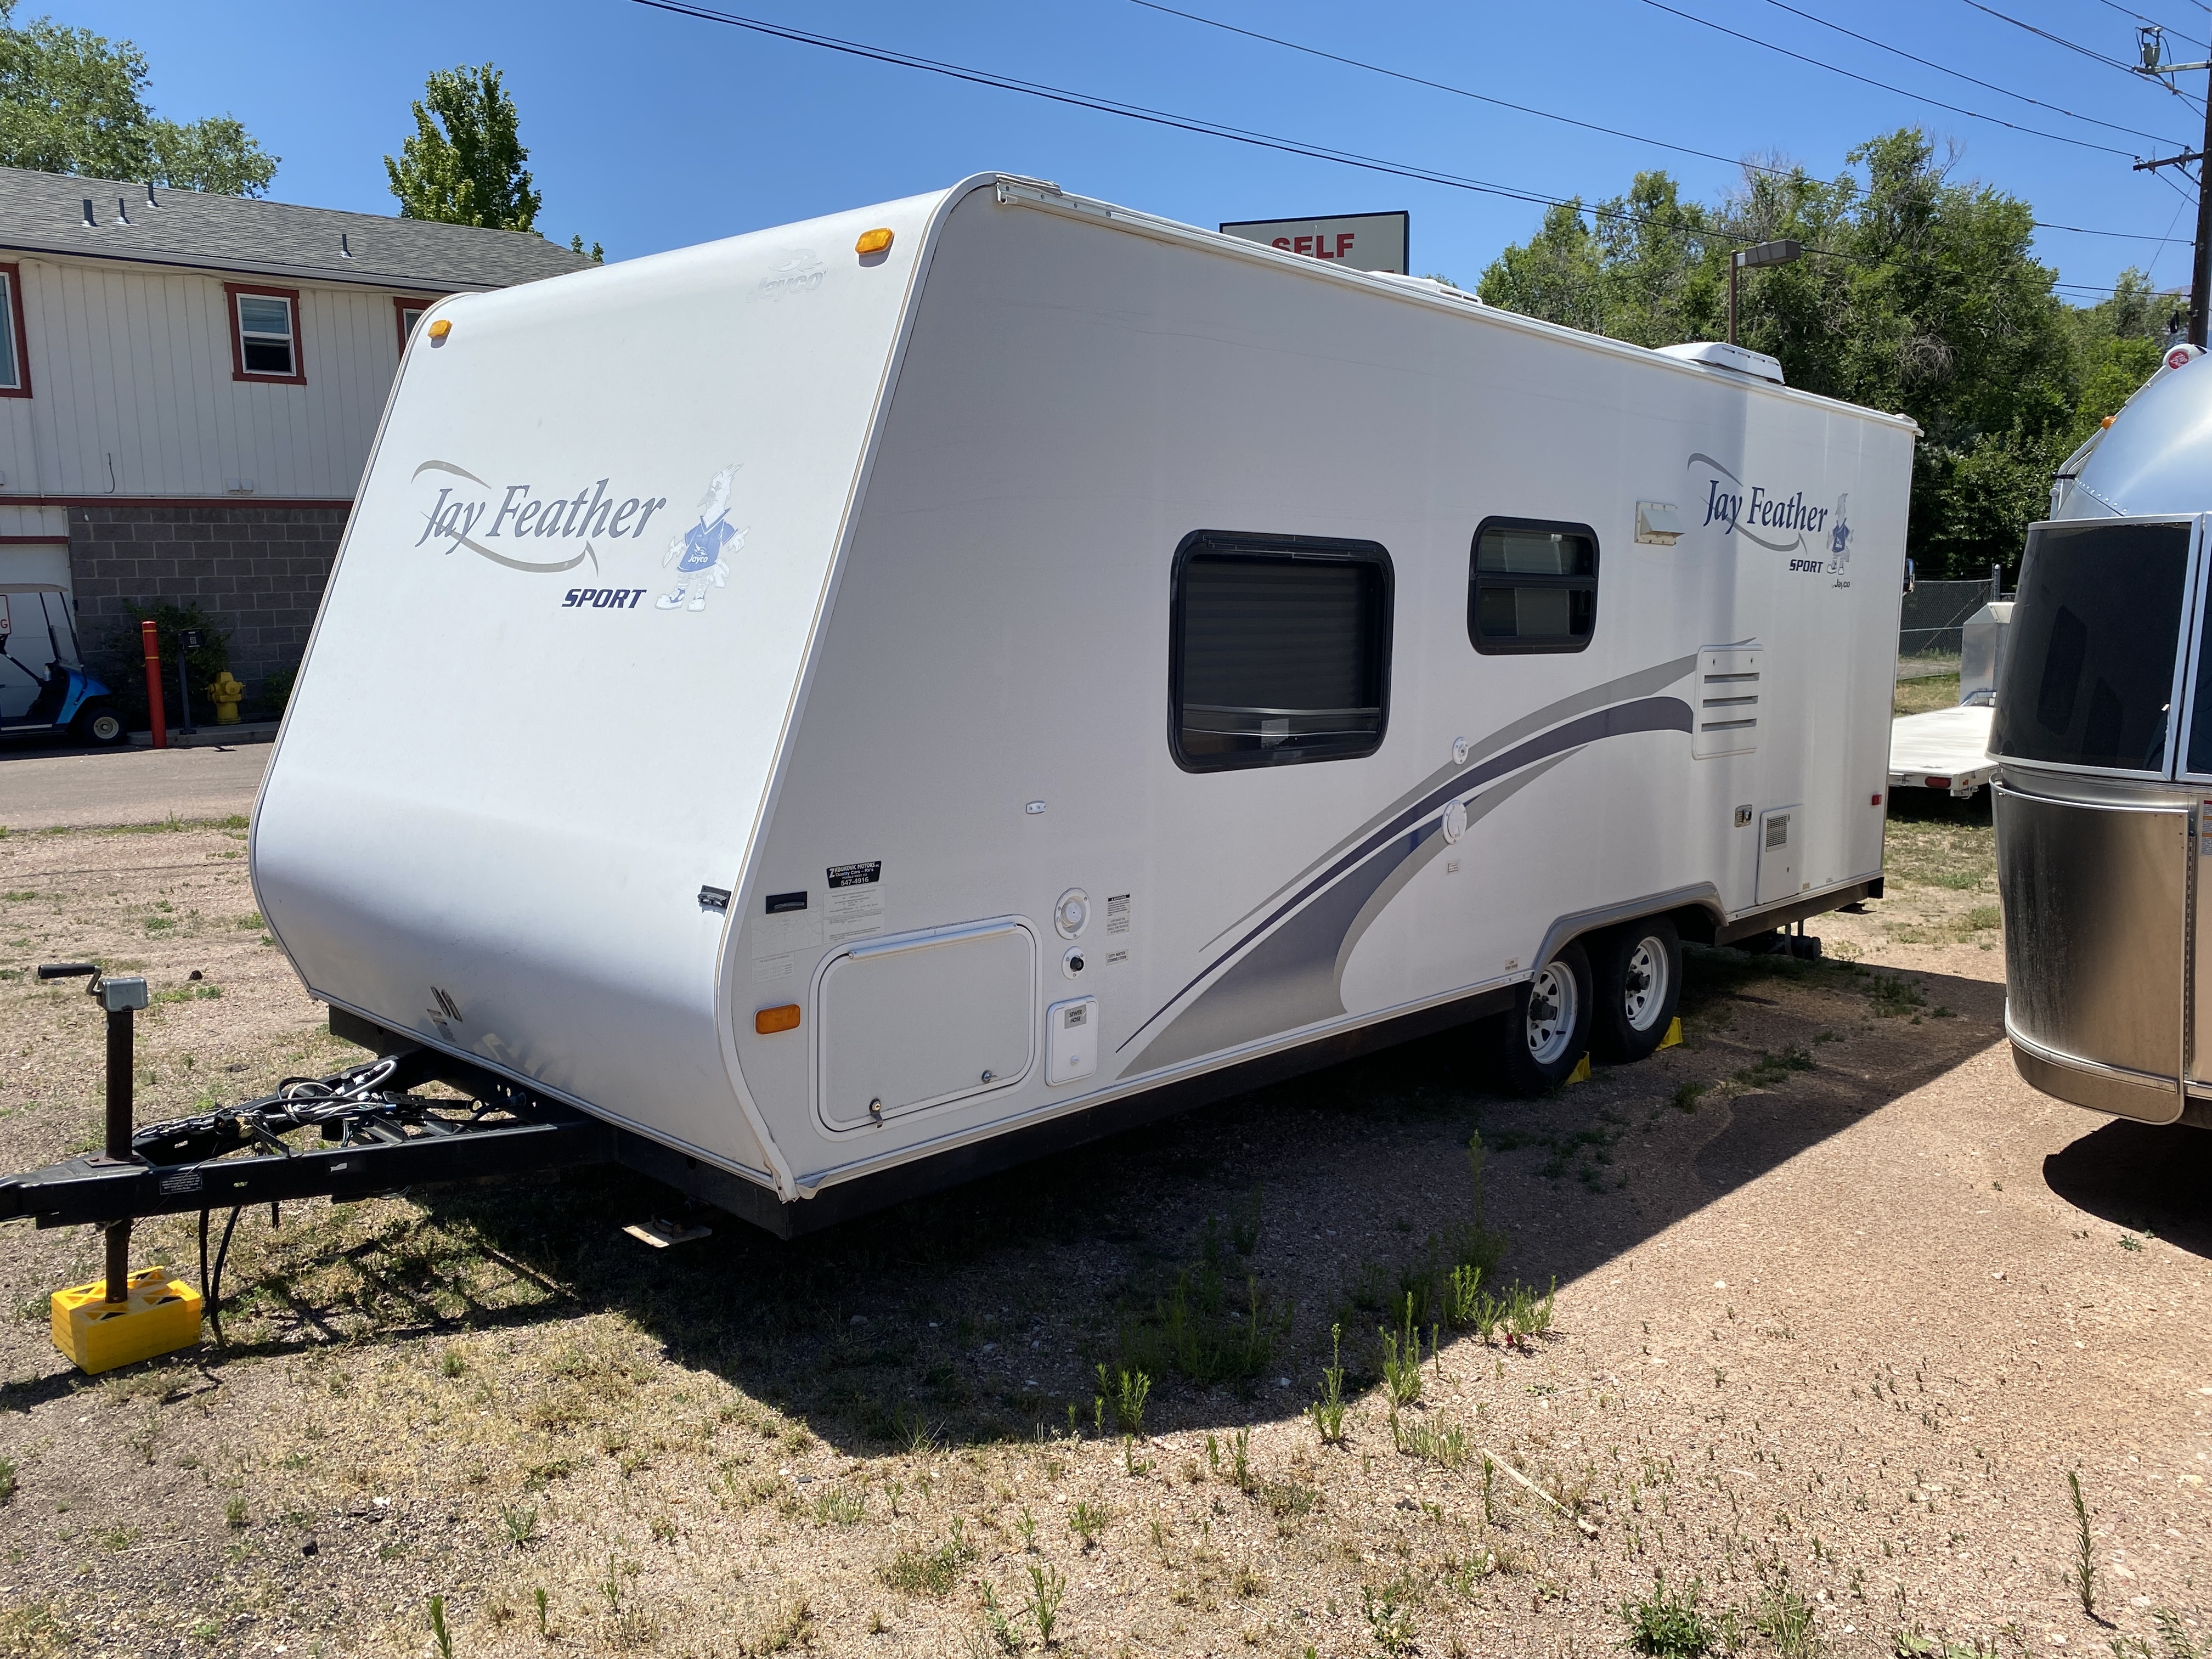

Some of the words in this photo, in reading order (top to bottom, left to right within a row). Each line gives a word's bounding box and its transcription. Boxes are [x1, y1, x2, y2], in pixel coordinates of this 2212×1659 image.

[1272, 233, 1355, 259] SELF
[1703, 479, 1743, 535] Jay
[1747, 487, 1828, 533] Feather
[415, 488, 485, 555] Jay
[486, 478, 667, 538] Feather
[688, 554, 708, 565] Jayco
[1789, 558, 1824, 574] SPORT
[561, 588, 647, 608] SPORT
[830, 865, 856, 878] ZABUKOVIC
[840, 877, 869, 886] 547-4916
